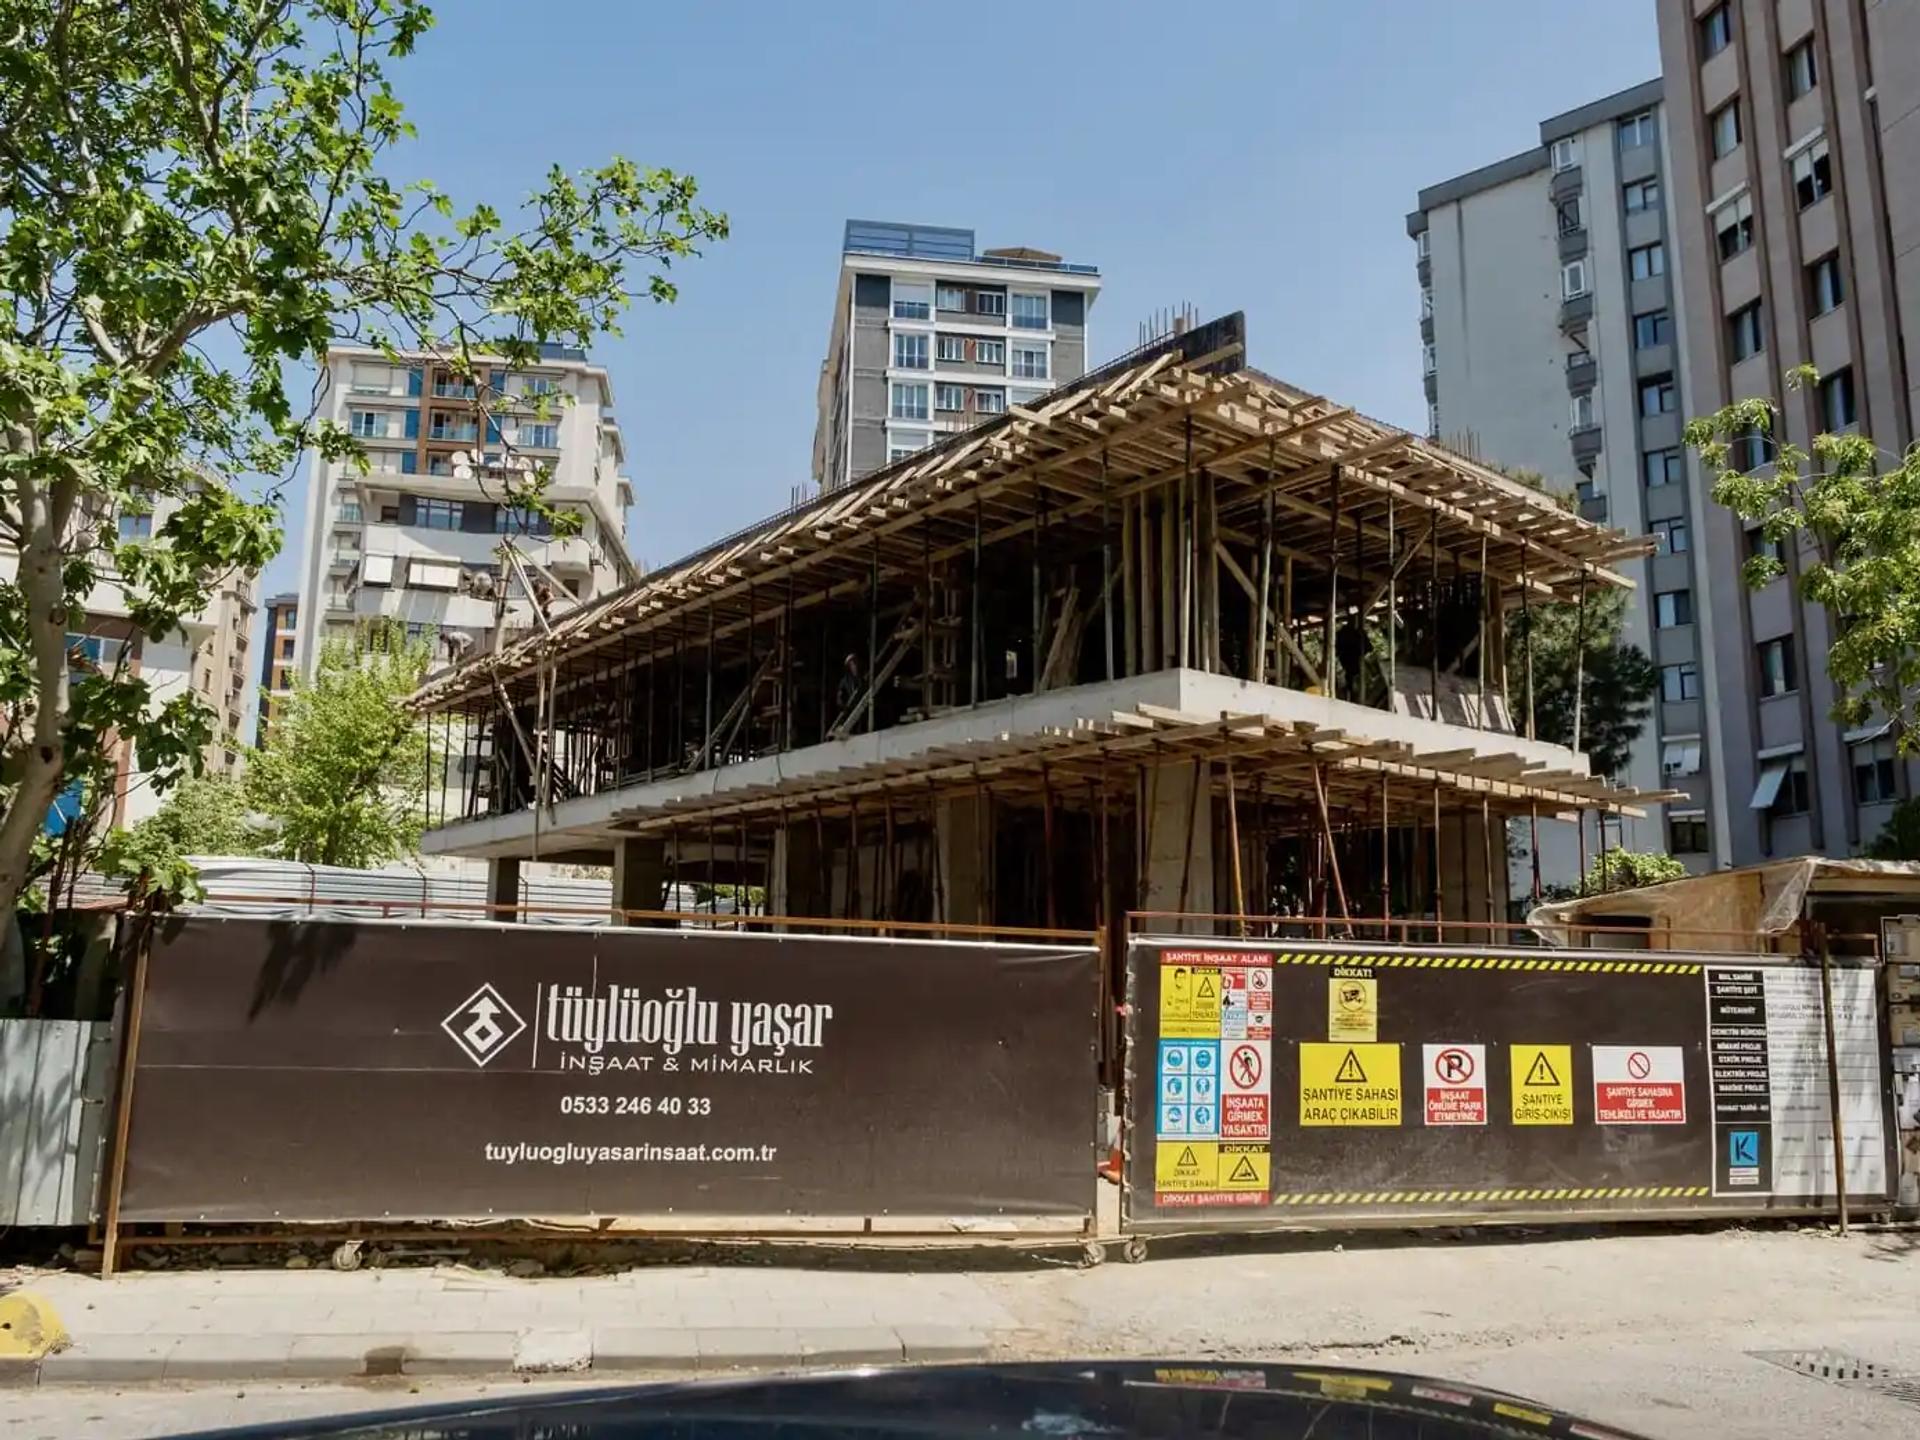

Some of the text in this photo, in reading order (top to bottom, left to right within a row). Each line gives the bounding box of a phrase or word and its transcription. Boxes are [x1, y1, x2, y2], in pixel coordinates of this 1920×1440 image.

[547, 983, 833, 1056] tüylüoğlu yaşar
[561, 1050, 814, 1075] İNŞAAT & MİMARLIK
[1303, 1087, 1399, 1105] ŞANTİYE SAHASI
[1522, 1093, 1563, 1106] ŞANTİYE
[1606, 1086, 1674, 1099] ŞANTİYE SAHASINA
[561, 1096, 711, 1115] 0533 246 40 33
[1226, 1094, 1264, 1111] İNŞAATA
[1227, 1109, 1263, 1122] GİRMEK
[1304, 1105, 1399, 1123] ARAÇ ÇIKABİLİR
[1514, 1107, 1571, 1122] GİRİŞ-ÇIKIŞI
[1600, 1108, 1681, 1119] TEHLİKELİ VE YASAKTIR
[1223, 1124, 1267, 1137] YASAKTIR
[485, 1142, 776, 1166] tuyluogluyasarinsaat.com.tr
[1224, 1144, 1265, 1153] DİKKAT
